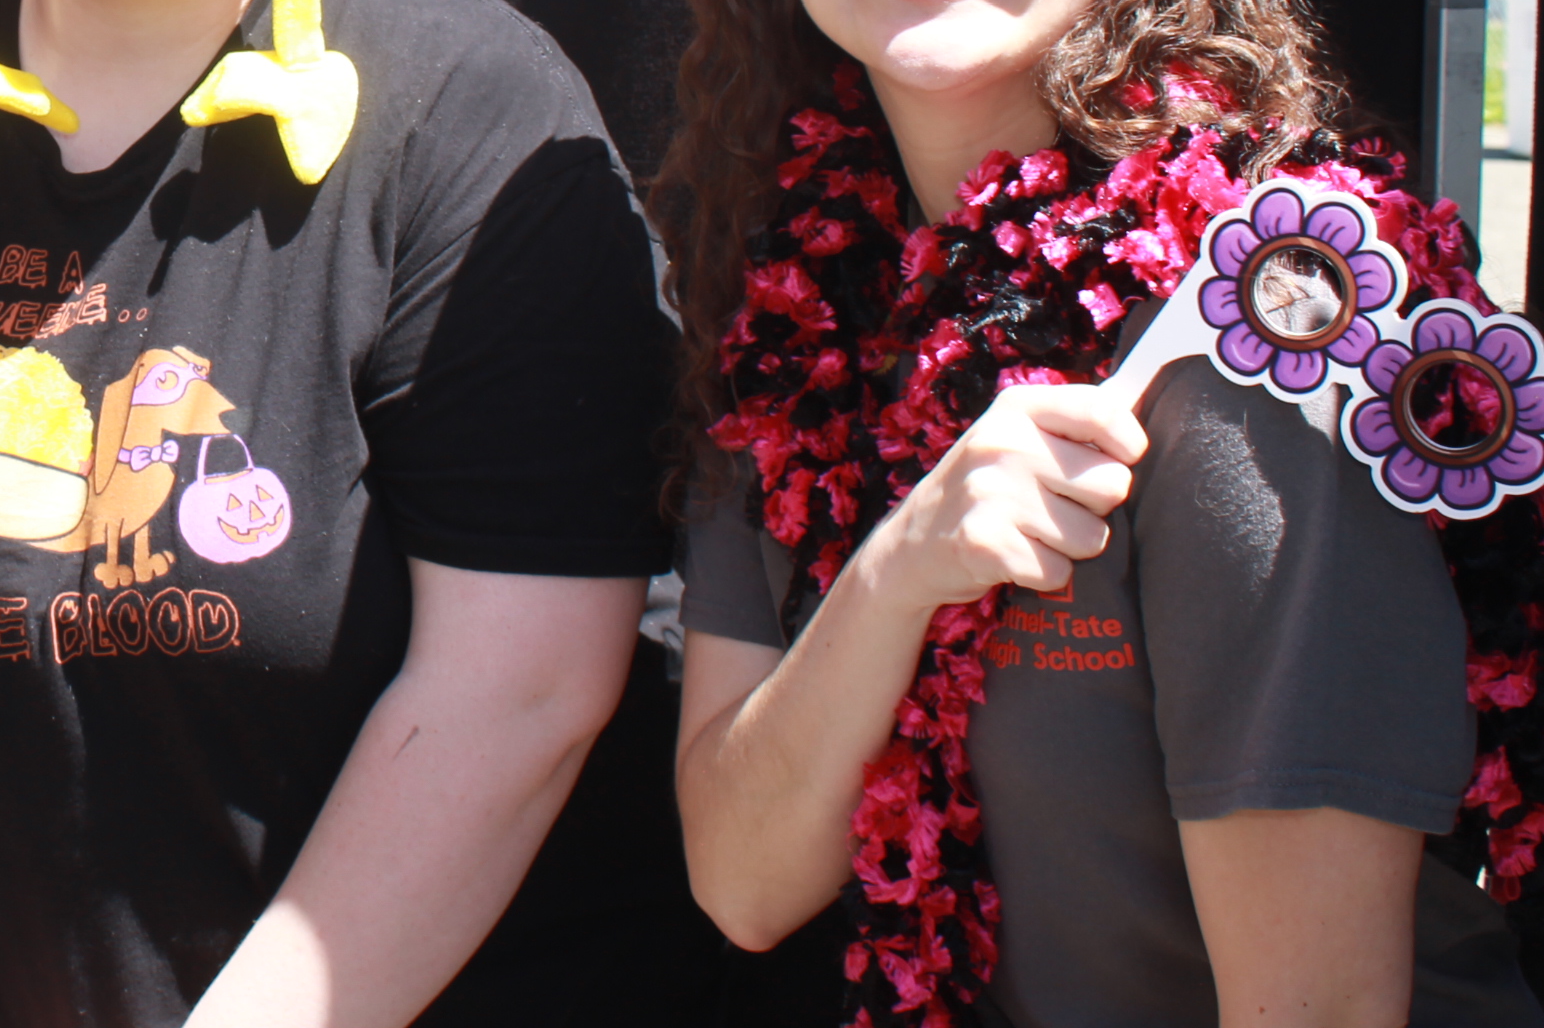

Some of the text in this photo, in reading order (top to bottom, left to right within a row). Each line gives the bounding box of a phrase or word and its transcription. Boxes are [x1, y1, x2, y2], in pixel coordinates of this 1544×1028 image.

[58, 250, 85, 295] A
[50, 586, 242, 665] BLOOD
[1033, 641, 1137, 672] School
